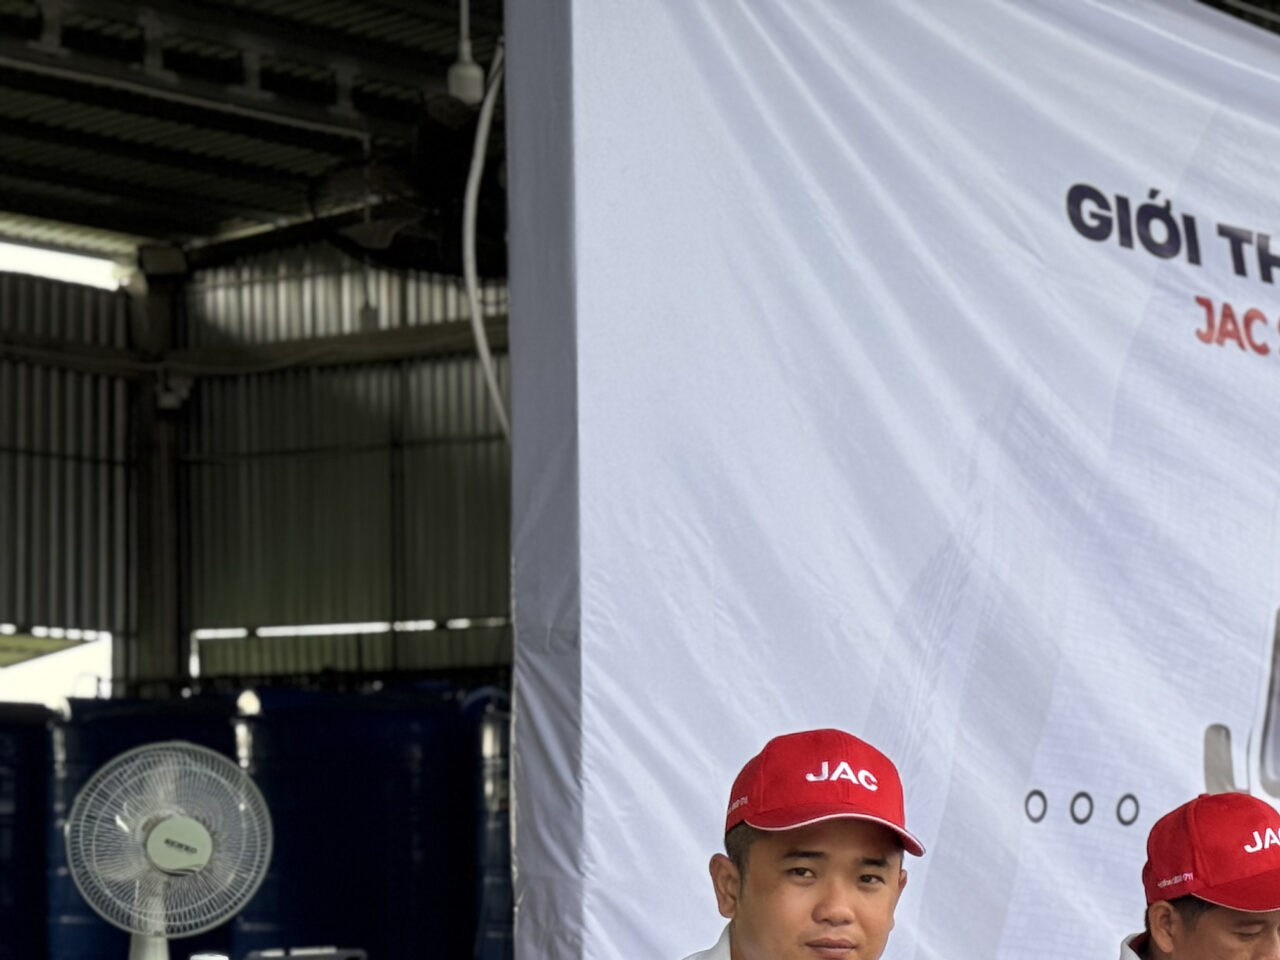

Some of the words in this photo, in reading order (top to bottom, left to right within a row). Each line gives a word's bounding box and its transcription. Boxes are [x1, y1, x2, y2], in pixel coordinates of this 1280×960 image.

[1066, 183, 1204, 267] GIỚI
[1194, 295, 1269, 356] JAC
[805, 761, 878, 791] JAC
